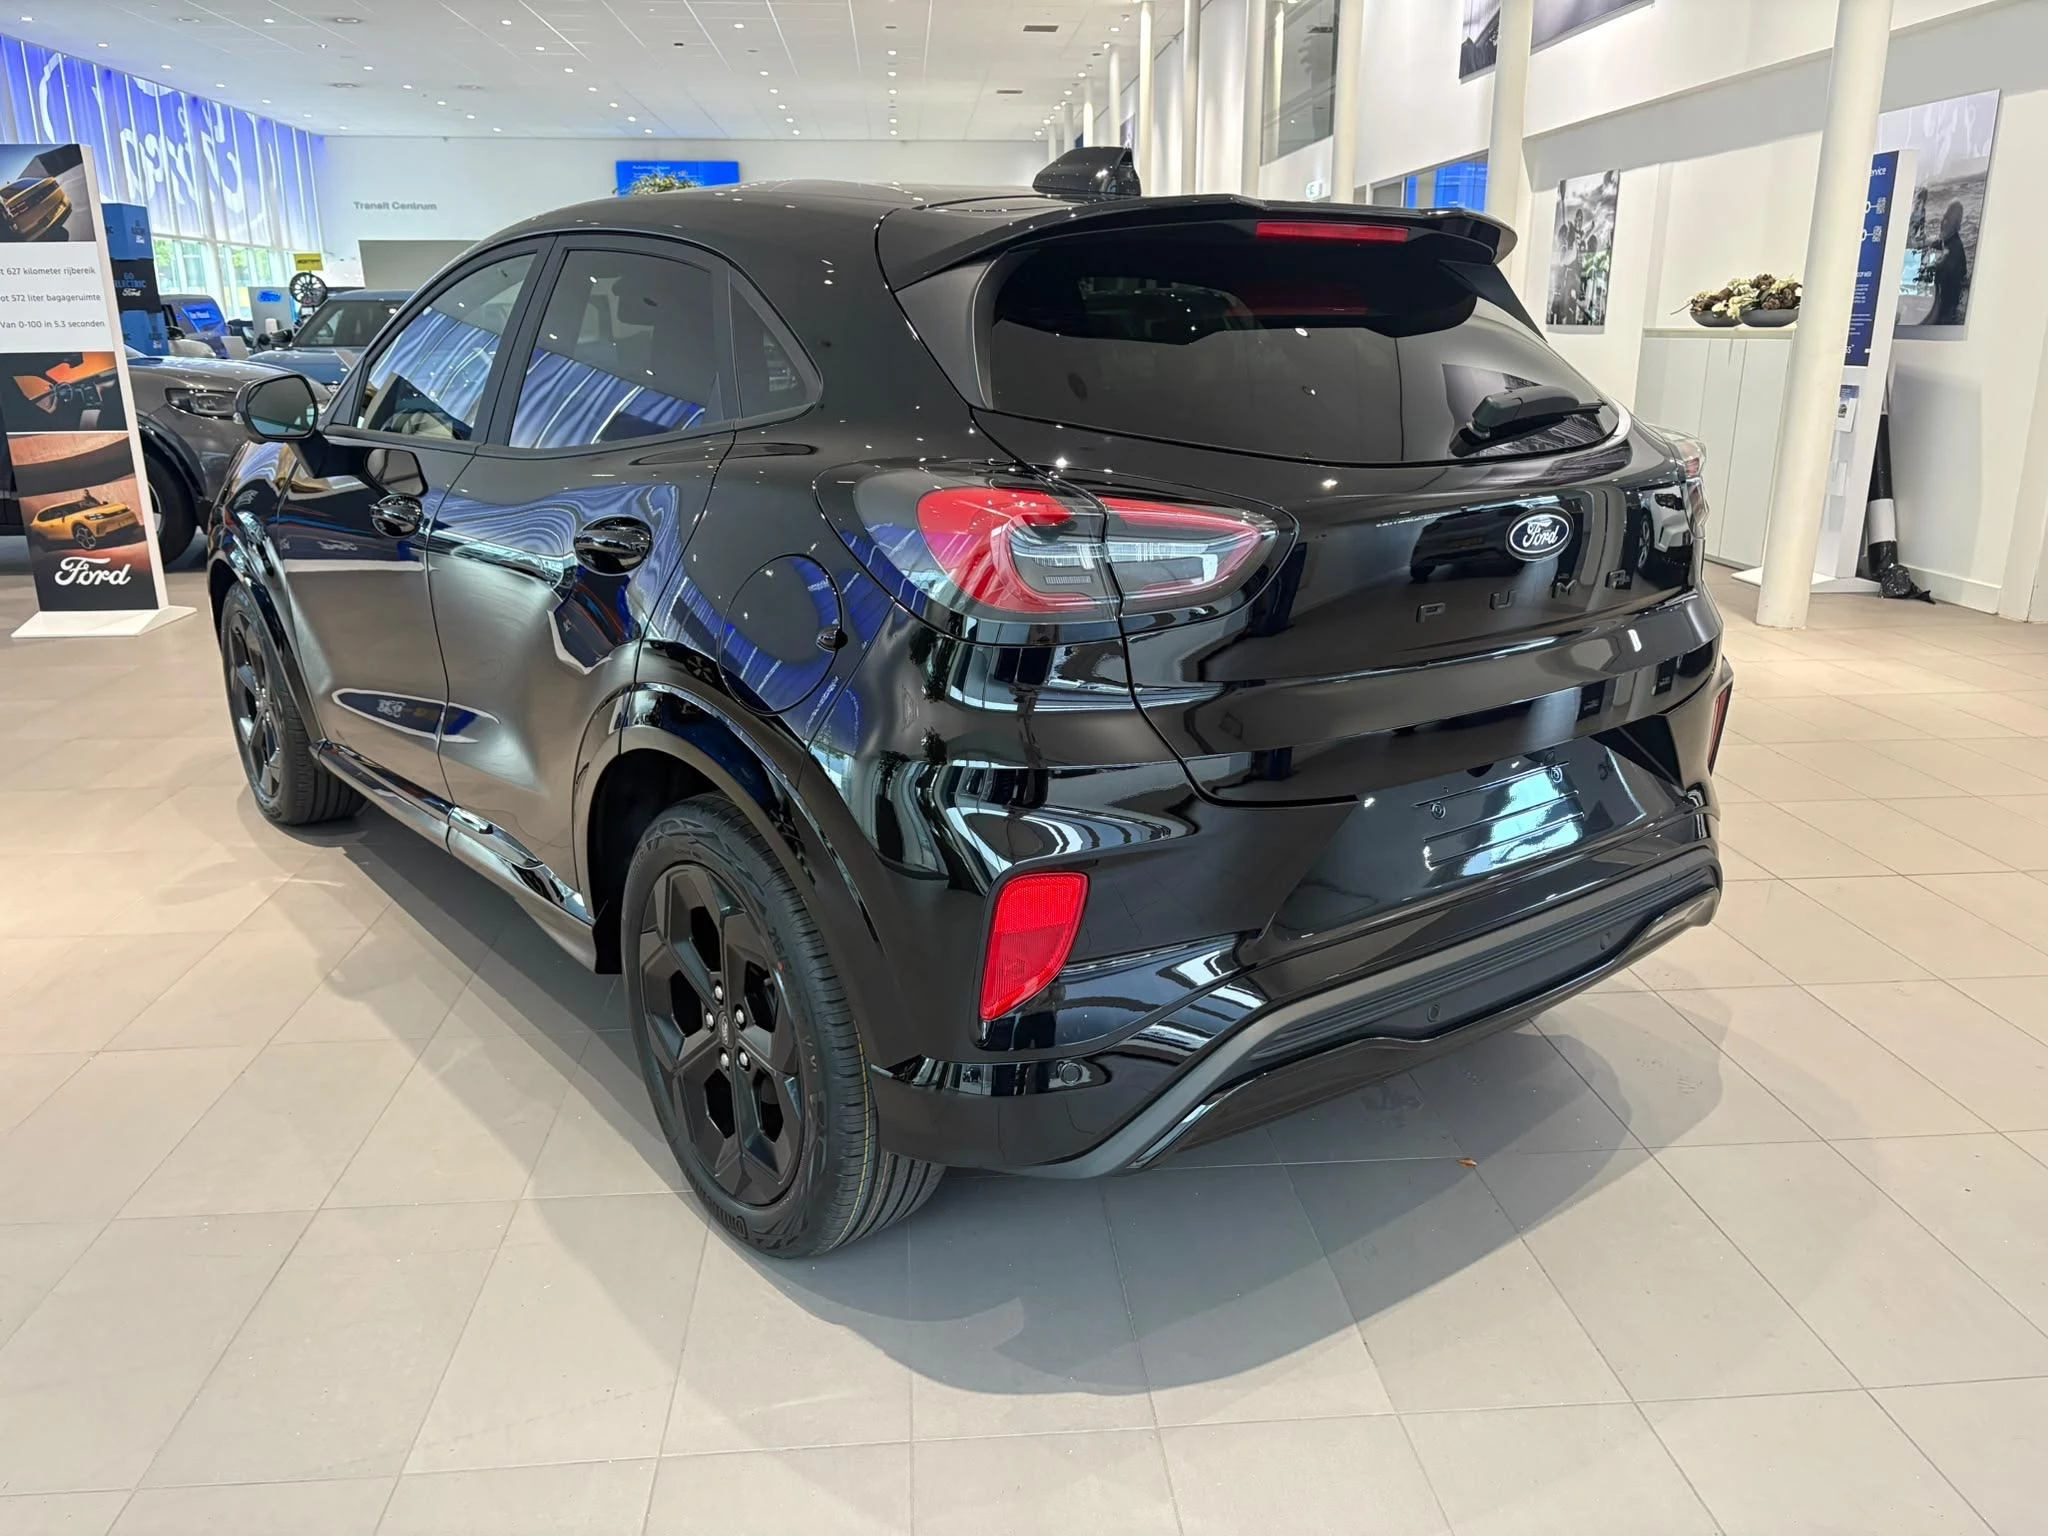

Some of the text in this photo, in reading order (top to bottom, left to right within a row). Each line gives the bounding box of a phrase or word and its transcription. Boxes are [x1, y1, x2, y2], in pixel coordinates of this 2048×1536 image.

[353, 201, 438, 210] Transit Centrum
[6, 267, 21, 275] 627
[23, 267, 61, 275] kilometer
[63, 267, 96, 276] rijbereik
[122, 288, 142, 297] Ford
[27, 294, 44, 302] liter
[46, 294, 101, 303] bagageruimte
[44, 320, 53, 328] in
[68, 320, 105, 328] seconden
[1522, 515, 1560, 548] Ford
[54, 556, 132, 586] Ford
[1416, 569, 1632, 622] PUMA
